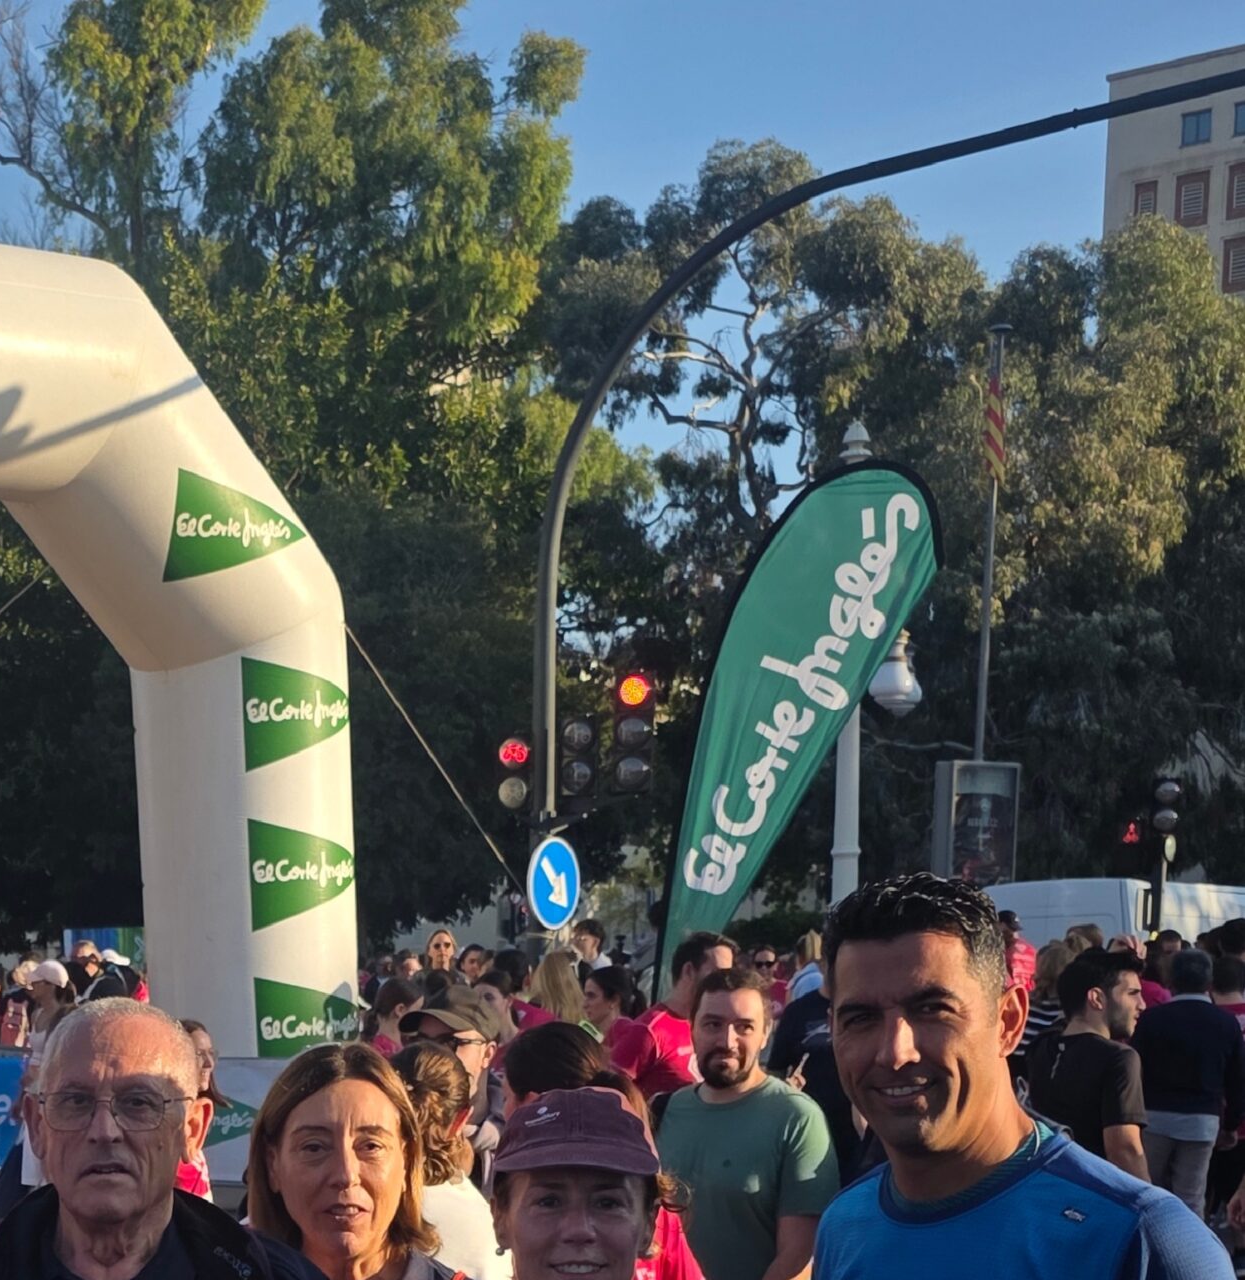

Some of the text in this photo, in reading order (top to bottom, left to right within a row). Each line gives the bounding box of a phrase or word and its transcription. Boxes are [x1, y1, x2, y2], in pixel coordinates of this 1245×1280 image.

[176, 507, 291, 548] El Corte Inglés
[684, 493, 919, 895] El Corte Inglés
[246, 698, 269, 723] El
[269, 698, 313, 722] Corte
[253, 859, 275, 883] El
[275, 859, 318, 881] Corte
[260, 1016, 282, 1040] El
[282, 1015, 325, 1039] Corte
[213, 1111, 255, 1135] nglés
